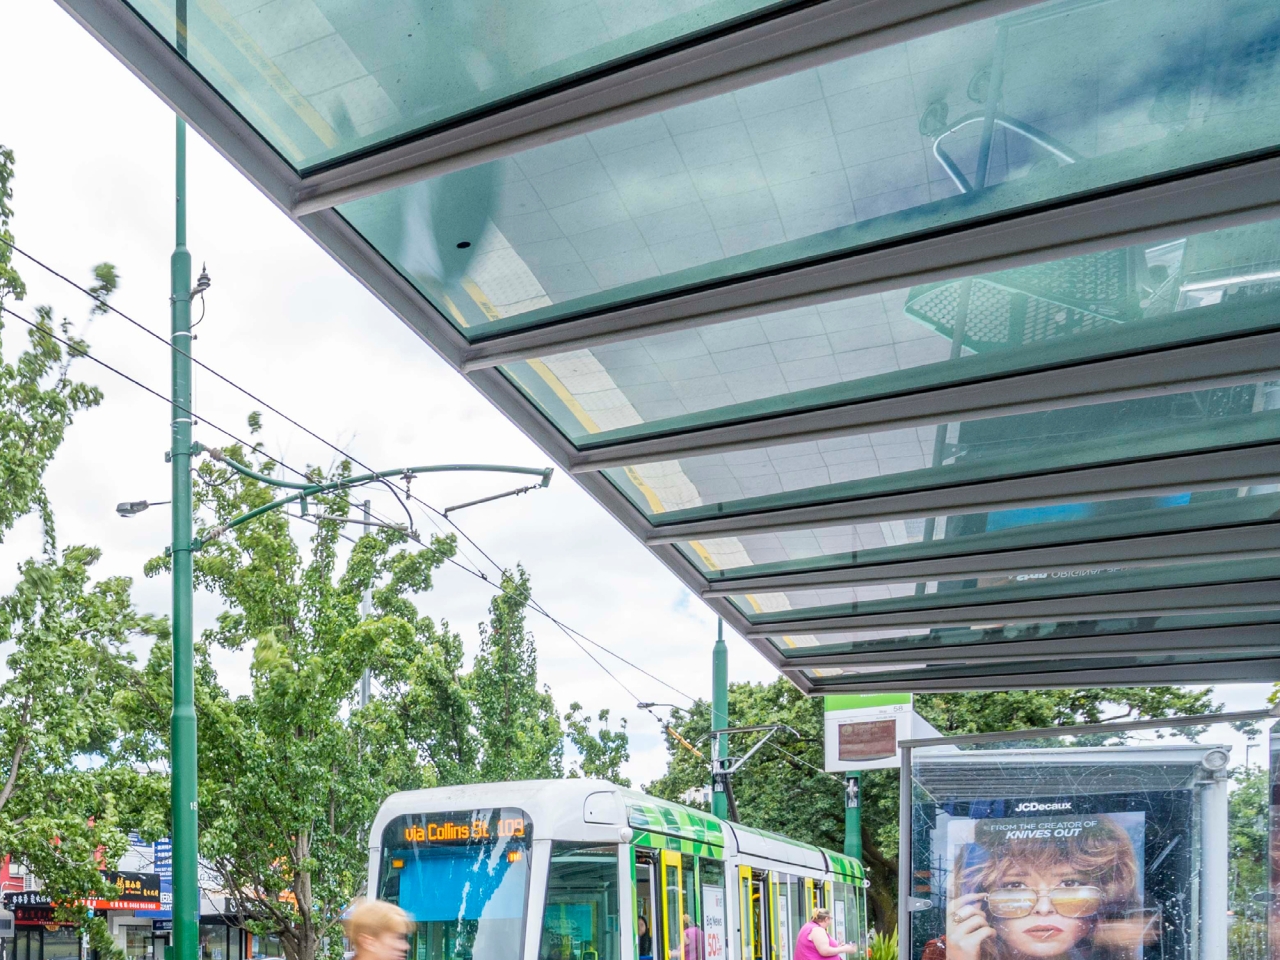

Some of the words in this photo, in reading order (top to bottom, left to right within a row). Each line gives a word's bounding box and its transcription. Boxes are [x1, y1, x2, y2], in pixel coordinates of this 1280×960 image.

[893, 705, 904, 713] 58
[1015, 801, 1072, 812] JCDecaux
[405, 825, 425, 841] via
[428, 822, 470, 840] Collins
[472, 820, 489, 838] St
[497, 819, 524, 836] 109
[1038, 821, 1082, 829] CREATOR
[1006, 829, 1051, 839] KNIVES
[1054, 828, 1083, 837] OUT
